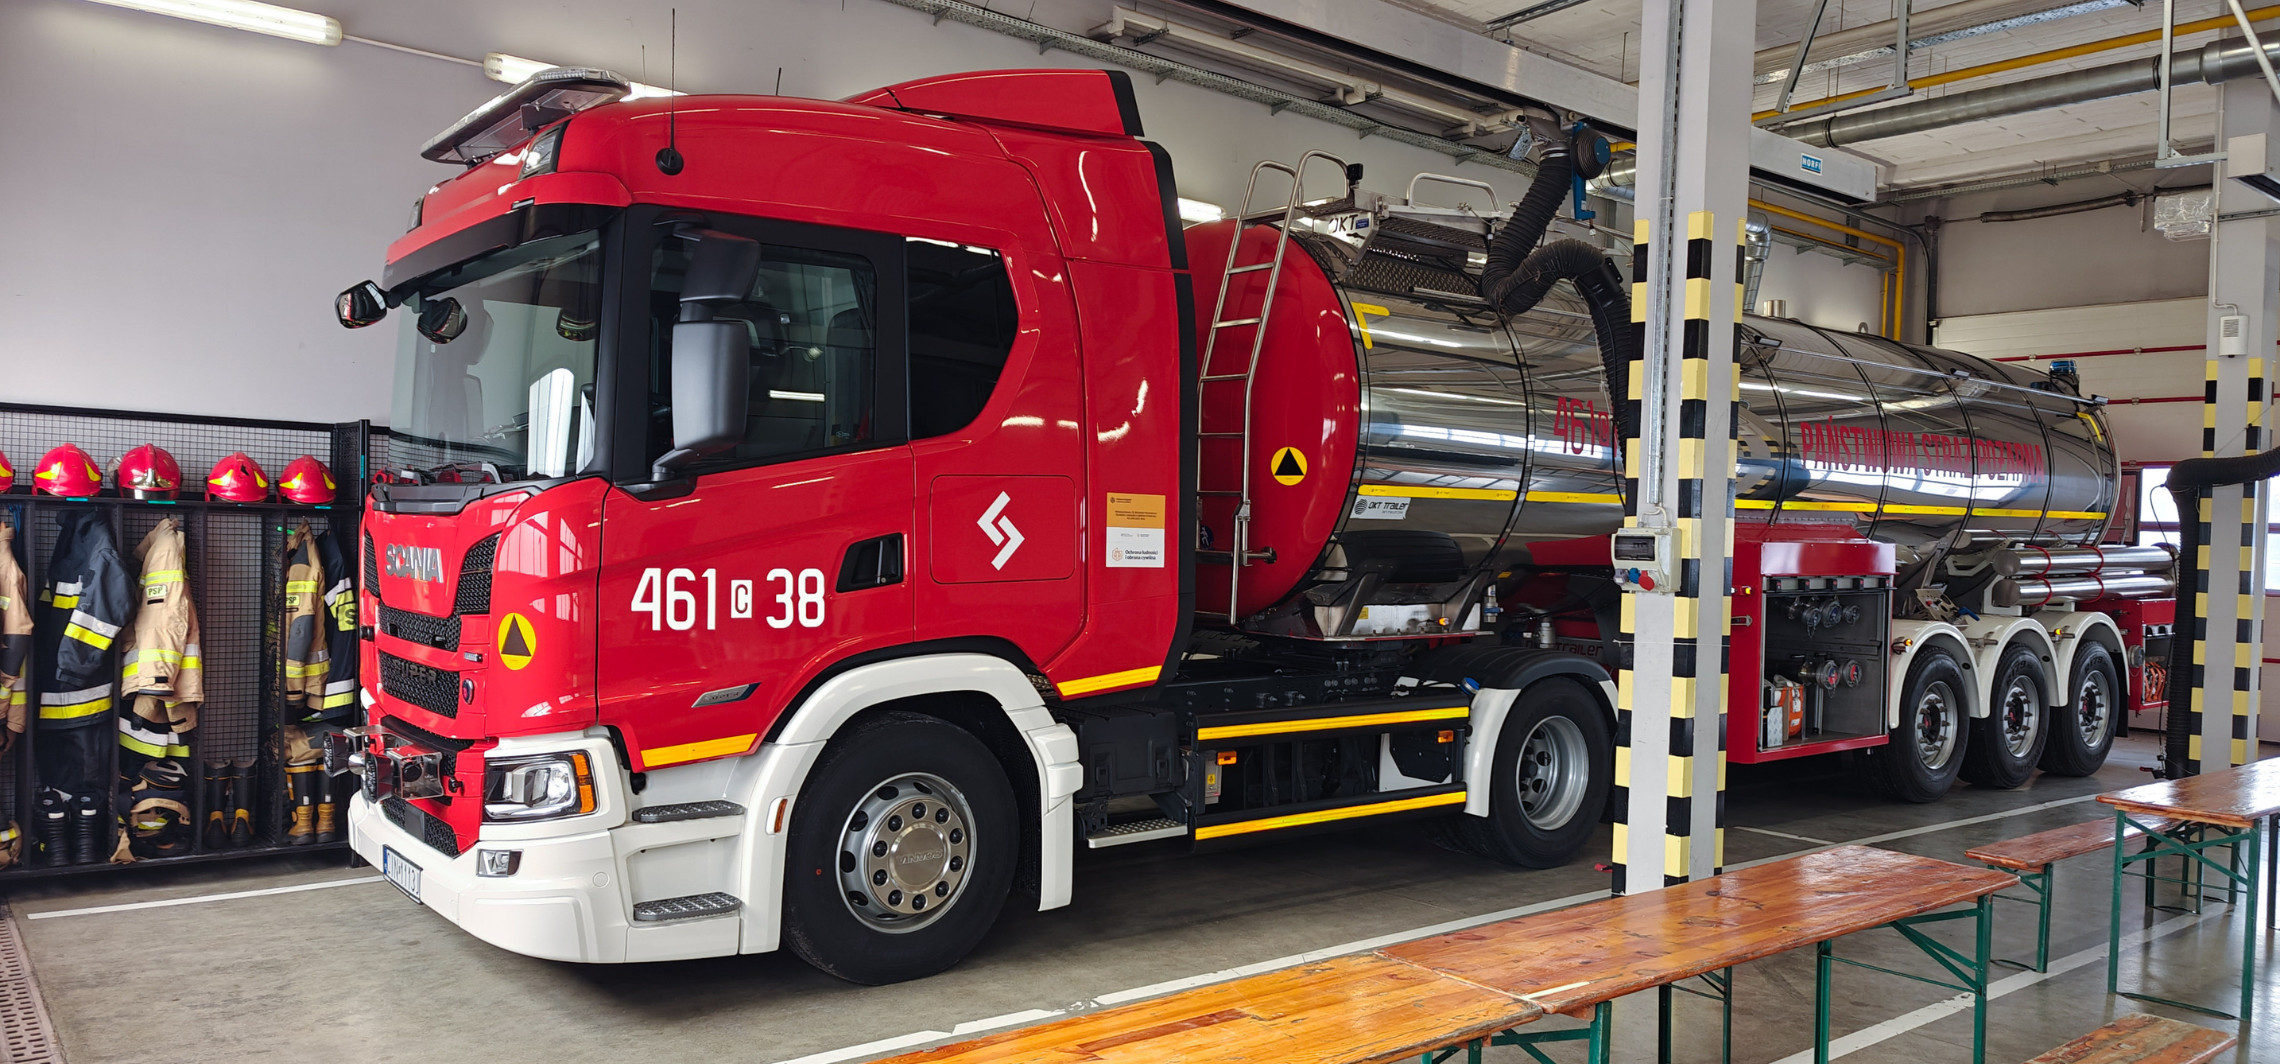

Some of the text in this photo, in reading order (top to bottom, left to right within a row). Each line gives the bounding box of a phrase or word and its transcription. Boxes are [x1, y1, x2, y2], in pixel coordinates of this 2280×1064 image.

[1802, 157, 1821, 170] NORFI
[1554, 397, 1595, 455] 461
[1800, 416, 1918, 475] PAŃSTWOWA
[386, 543, 444, 583] SCANIA
[631, 567, 825, 631] 461 C 38
[392, 659, 437, 687] SUPER
[896, 849, 943, 864] SCANIA
